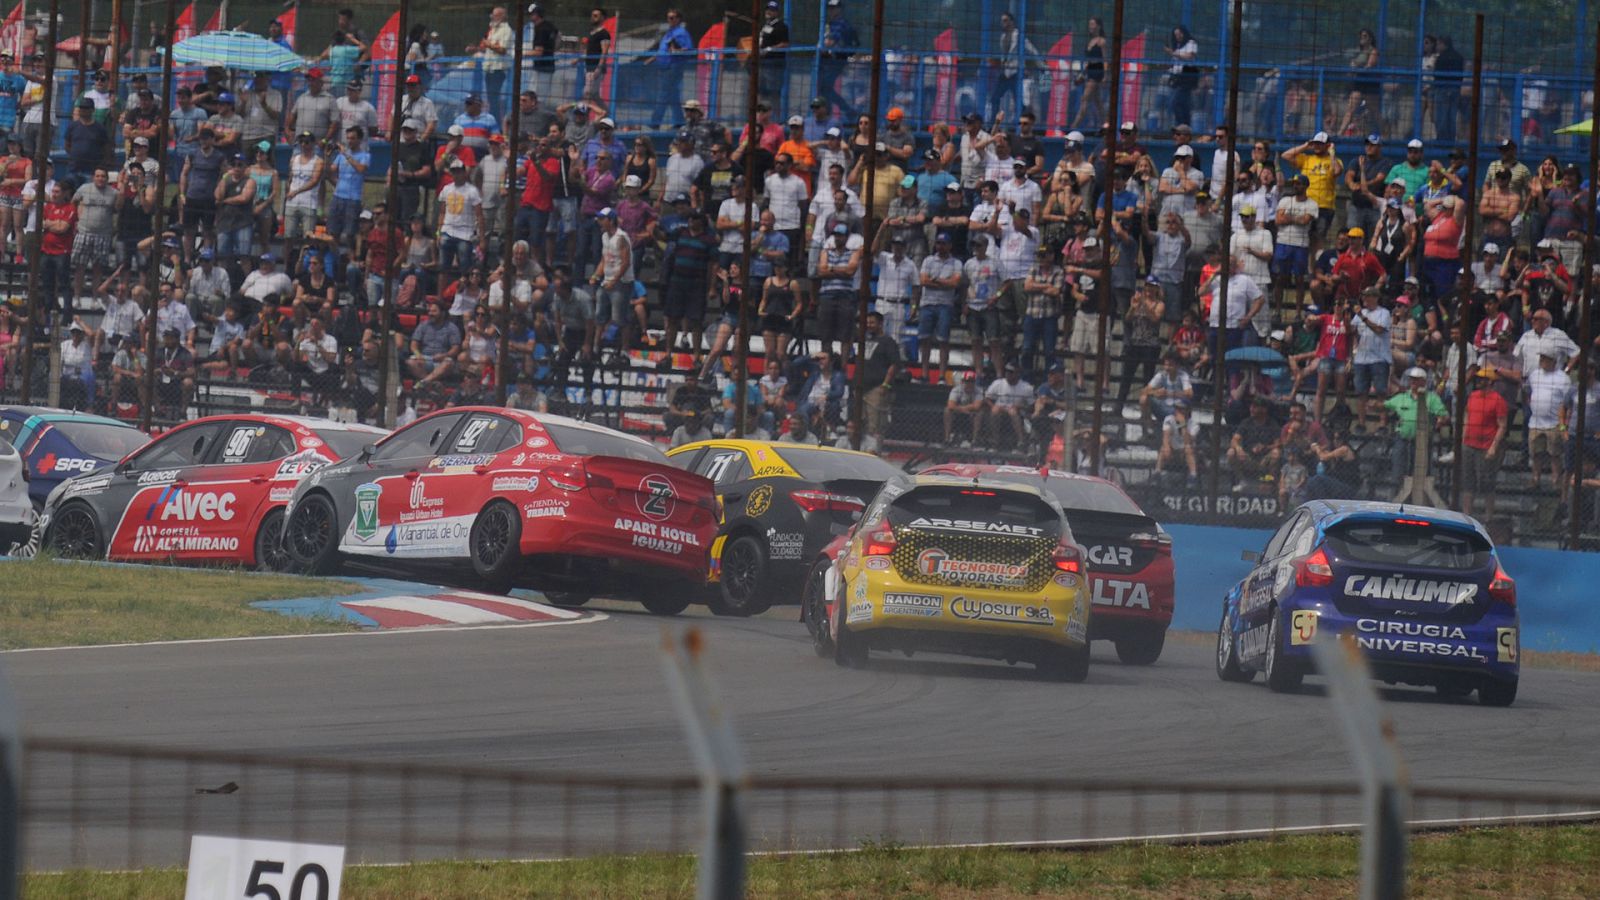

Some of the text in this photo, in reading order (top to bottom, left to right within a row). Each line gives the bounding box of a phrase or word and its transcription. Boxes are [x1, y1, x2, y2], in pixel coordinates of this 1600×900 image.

[459, 419, 489, 447] 92
[225, 429, 256, 456] 96
[54, 458, 97, 472] SPG
[161, 489, 236, 521] Avec
[422, 497, 444, 508] Express
[531, 499, 558, 508] TIENDA
[527, 506, 565, 518] URBANA
[398, 523, 469, 541] Manantial de Oro
[614, 518, 700, 546] APART HOTEL
[909, 517, 1044, 535] ARSEMET
[155, 536, 239, 551] ALTAMIRANO
[632, 534, 683, 555] IGUAZU
[942, 561, 1028, 576] TECNOSILOS
[941, 571, 1005, 585] TOTORAS
[886, 595, 940, 608] RANDON
[1090, 578, 1151, 610] LTA
[883, 605, 925, 616] ARGENTINA
[950, 596, 1022, 621] Cuyosur
[1356, 618, 1467, 640] CIRUGIA
[1336, 633, 1486, 660] NIVERSAL
